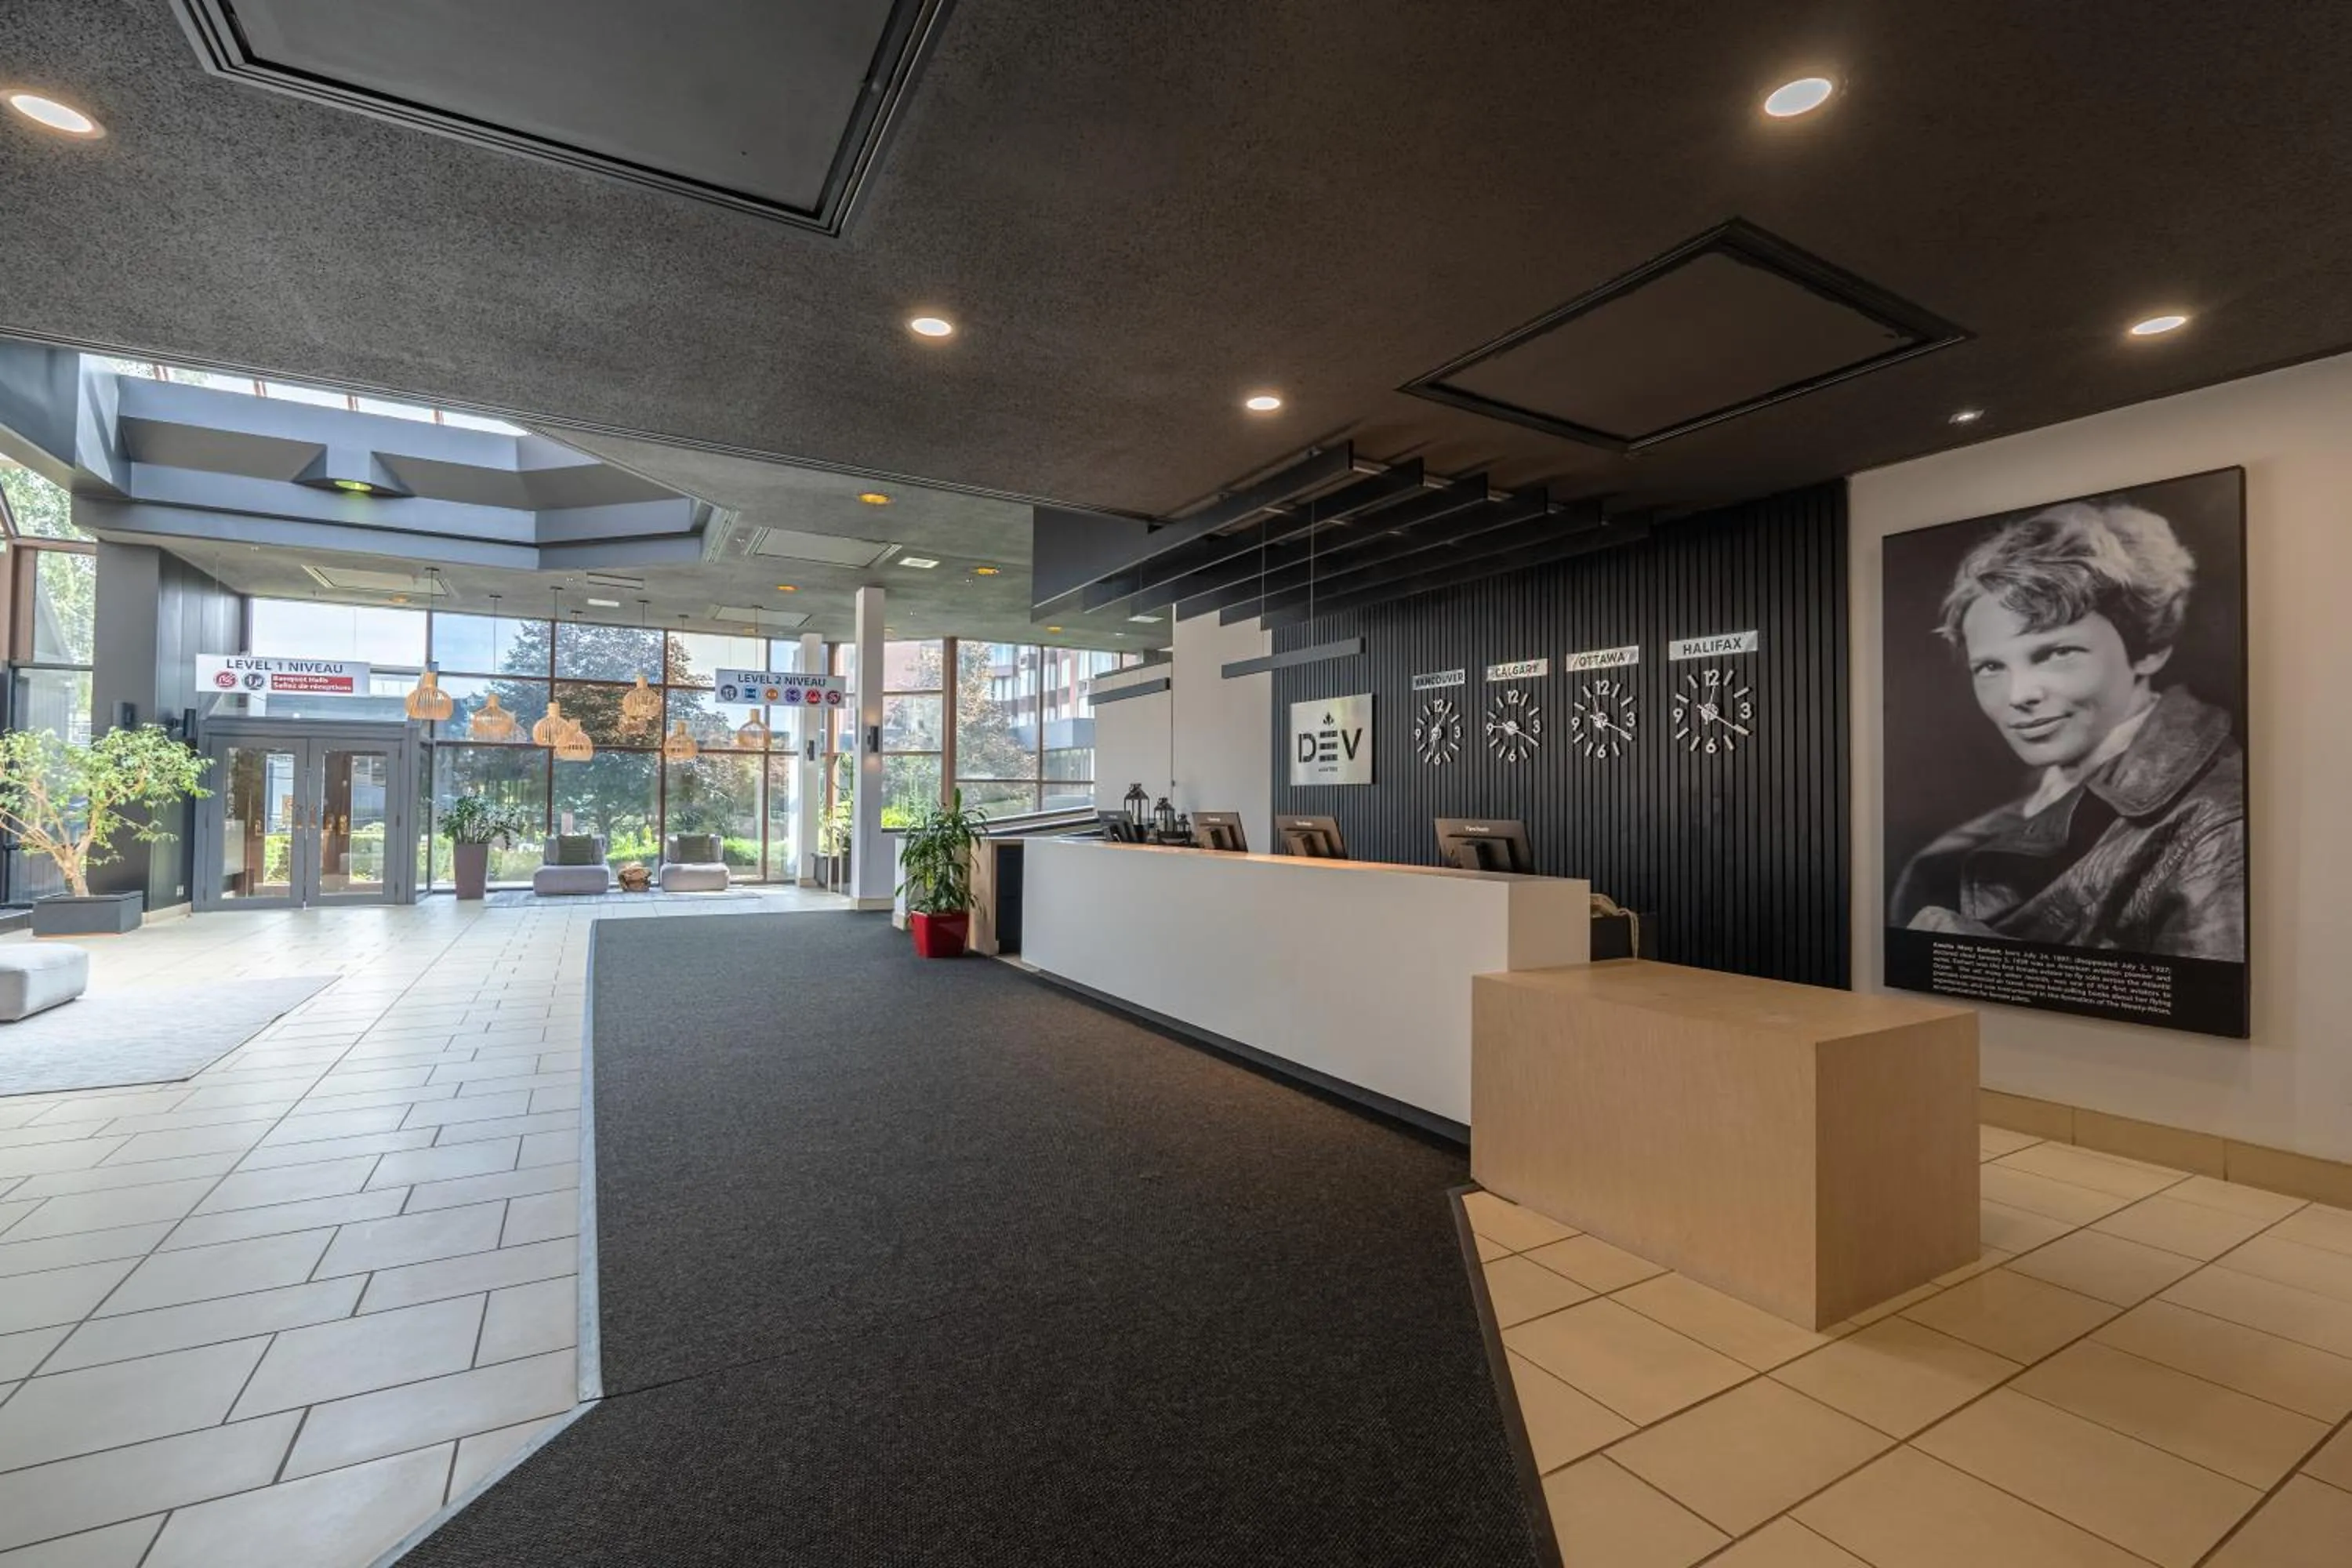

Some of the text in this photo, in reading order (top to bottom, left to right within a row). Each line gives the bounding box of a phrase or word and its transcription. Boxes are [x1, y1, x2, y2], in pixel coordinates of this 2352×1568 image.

[1683, 637, 1741, 655] HALIFAX
[227, 659, 343, 673] LEVEL 1 NIVEAU
[1578, 652, 1626, 666] OTTAWA
[1495, 662, 1539, 678] CALGARY
[738, 673, 827, 688] LEVEL 2 NIVEAU
[1415, 672, 1463, 687] VANCOUVER
[1703, 669, 1720, 687] 12
[1595, 680, 1610, 695] 12
[1508, 690, 1519, 704] 12
[1433, 699, 1444, 713] 12
[1740, 702, 1752, 720] 3
[1626, 711, 1635, 728] 3
[1673, 708, 1683, 724] 9
[1486, 722, 1494, 735] 9
[1533, 720, 1541, 734] 3
[1571, 717, 1580, 731] 9
[1415, 728, 1421, 741] 9
[1454, 725, 1461, 739] 3
[1298, 727, 1363, 763] DEV
[1597, 743, 1606, 758] 6
[1706, 738, 1716, 753] 6
[1435, 753, 1441, 765] 6
[1508, 749, 1516, 763] 6
